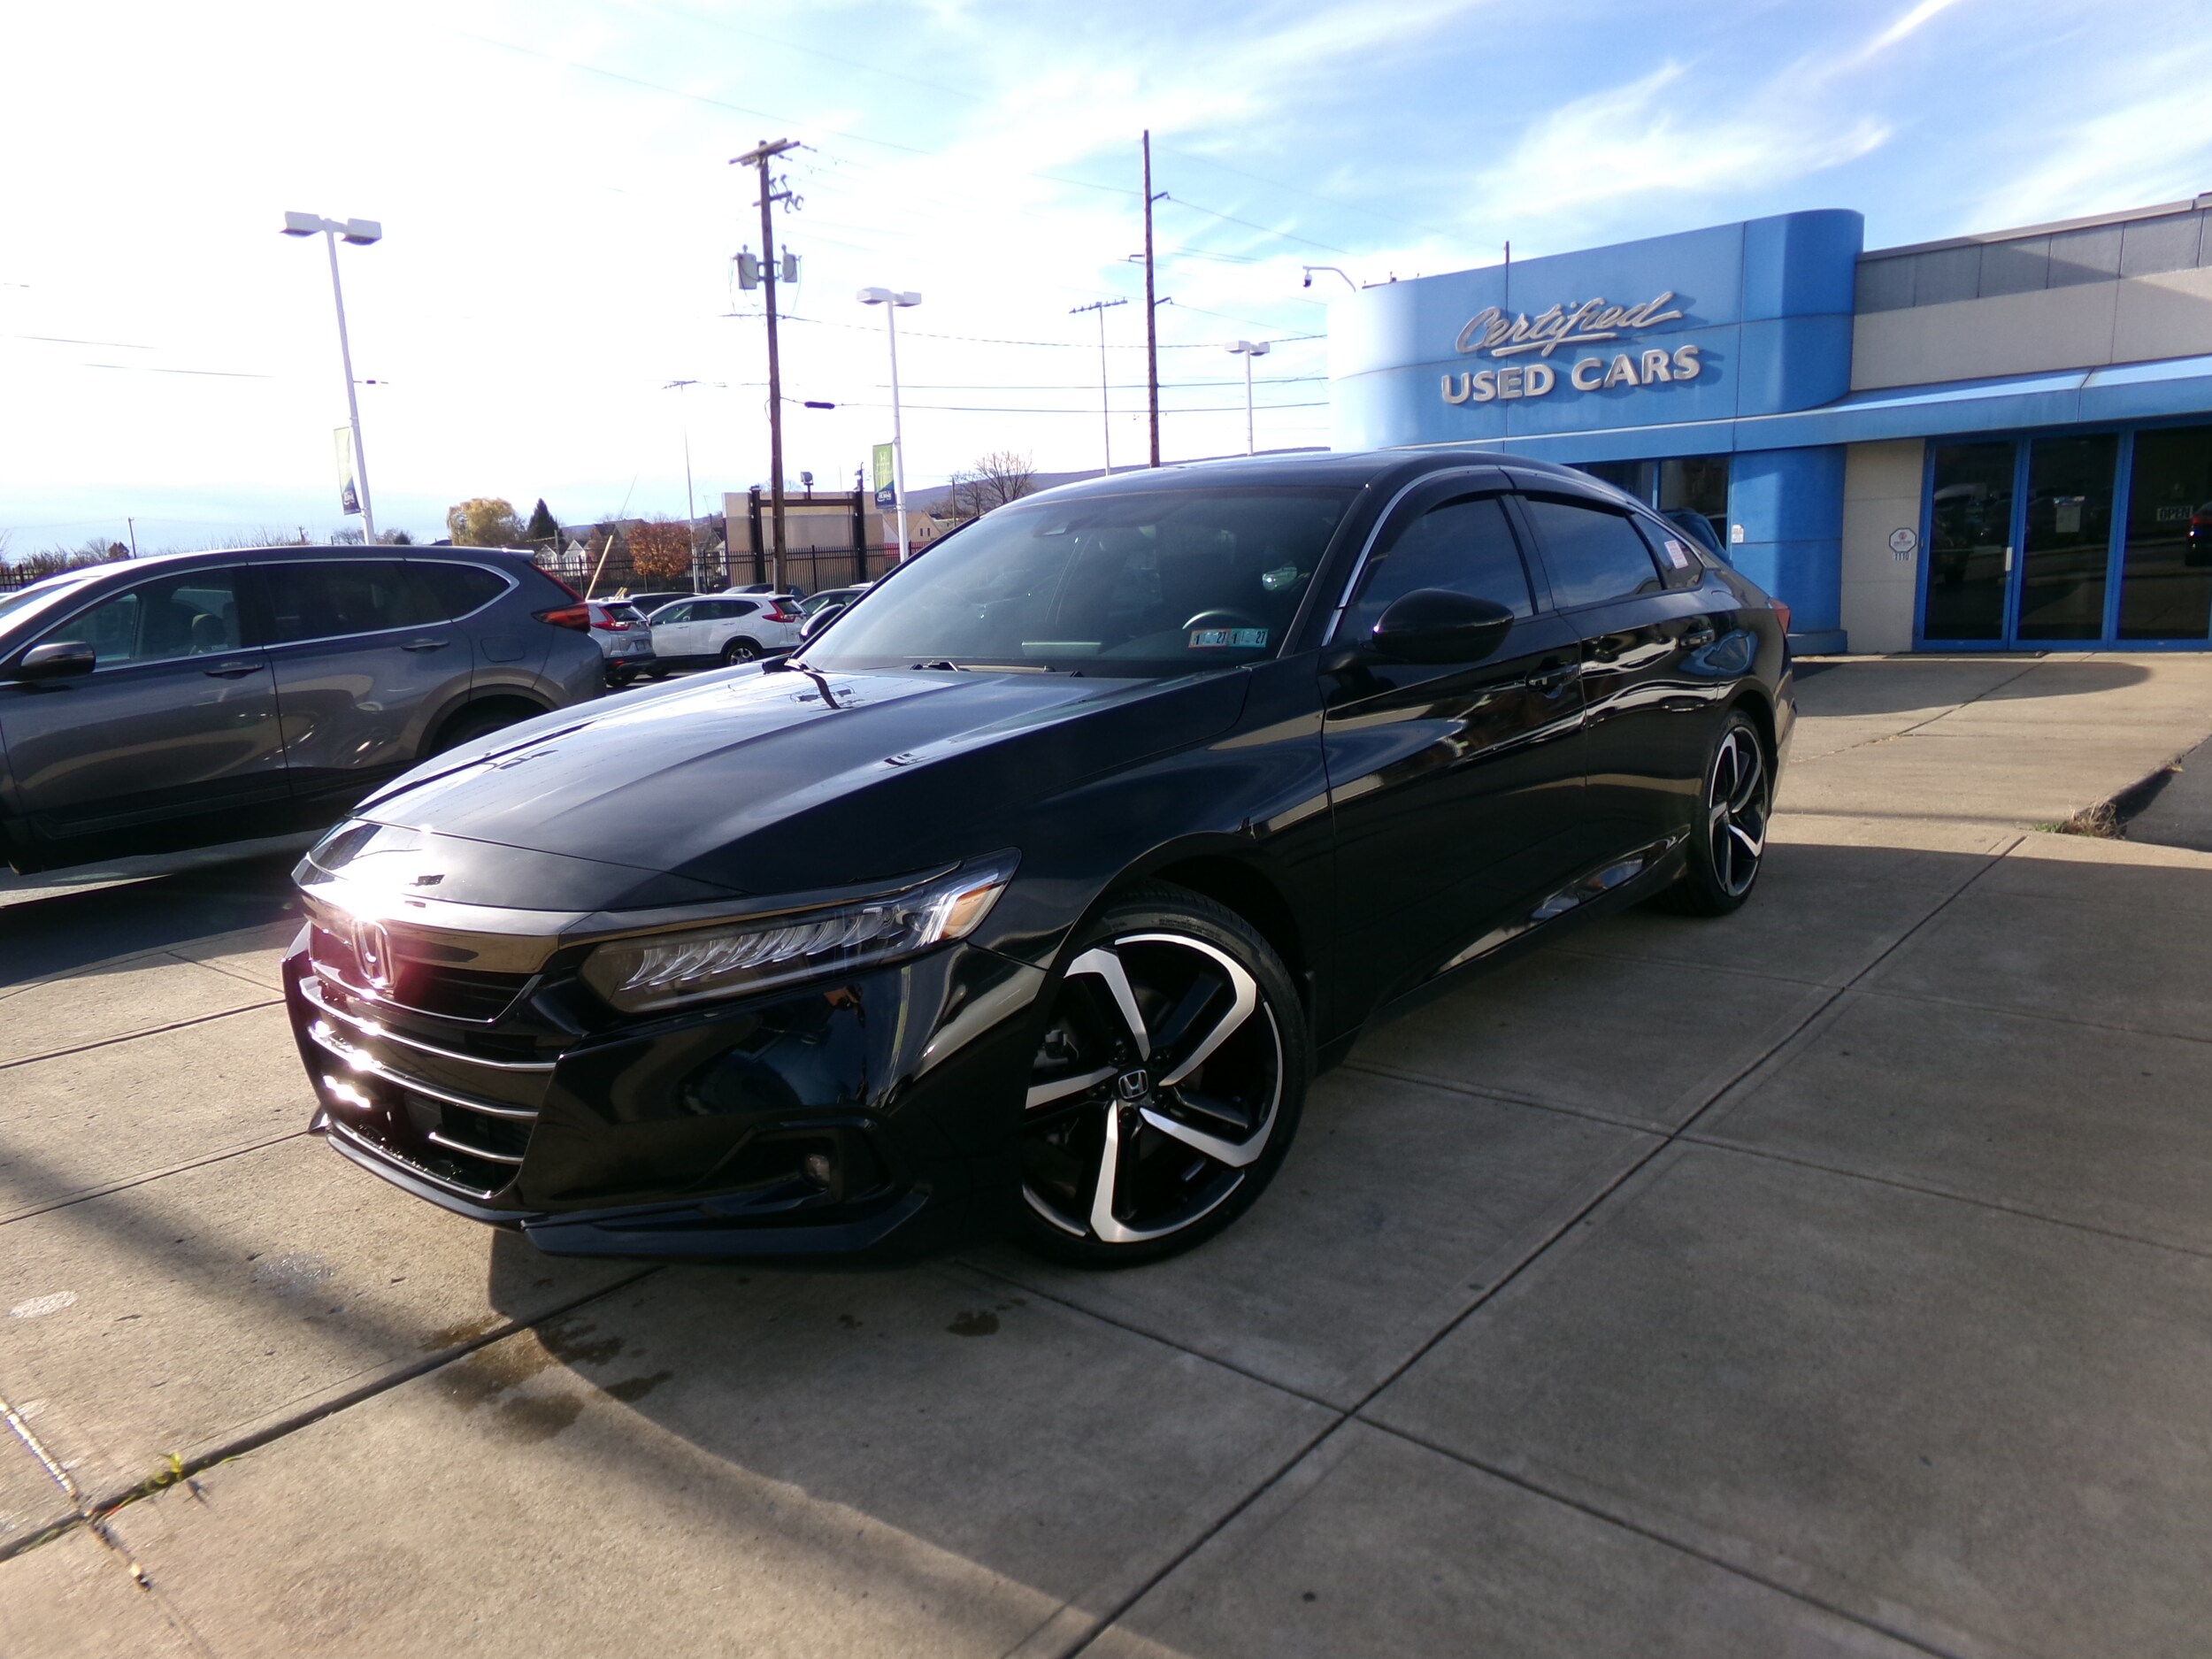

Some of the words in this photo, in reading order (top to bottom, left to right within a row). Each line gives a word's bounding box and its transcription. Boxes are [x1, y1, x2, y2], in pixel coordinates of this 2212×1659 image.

[1455, 290, 1683, 357] Certified
[1441, 364, 1555, 404] USED
[1571, 344, 1701, 391] CARS
[2160, 507, 2191, 519] OPEN
[1217, 630, 1227, 645] 27
[1255, 631, 1266, 645] 27
